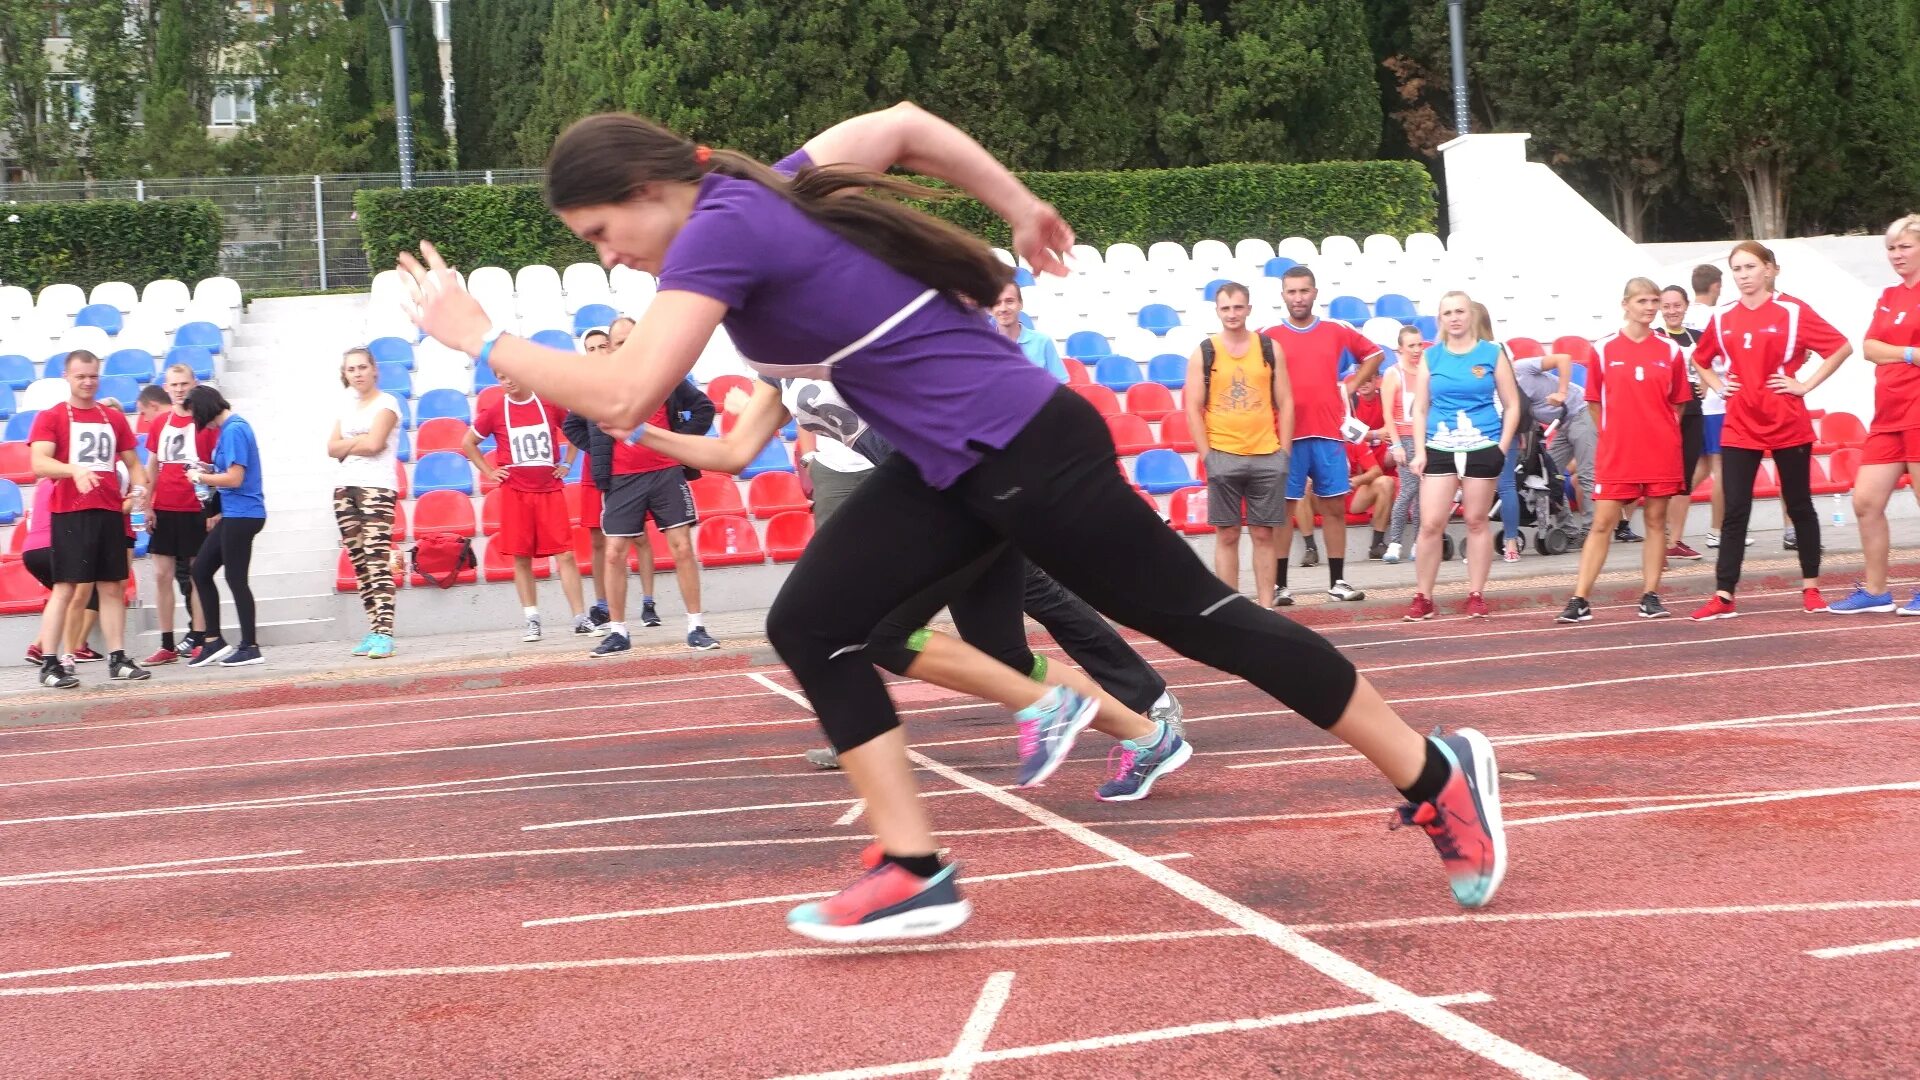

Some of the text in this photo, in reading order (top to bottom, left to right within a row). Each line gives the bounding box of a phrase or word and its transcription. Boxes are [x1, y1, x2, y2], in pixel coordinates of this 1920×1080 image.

[1743, 332, 1752, 349] 2
[78, 431, 111, 462] 20
[164, 434, 186, 460] 12
[512, 431, 551, 463] 103
